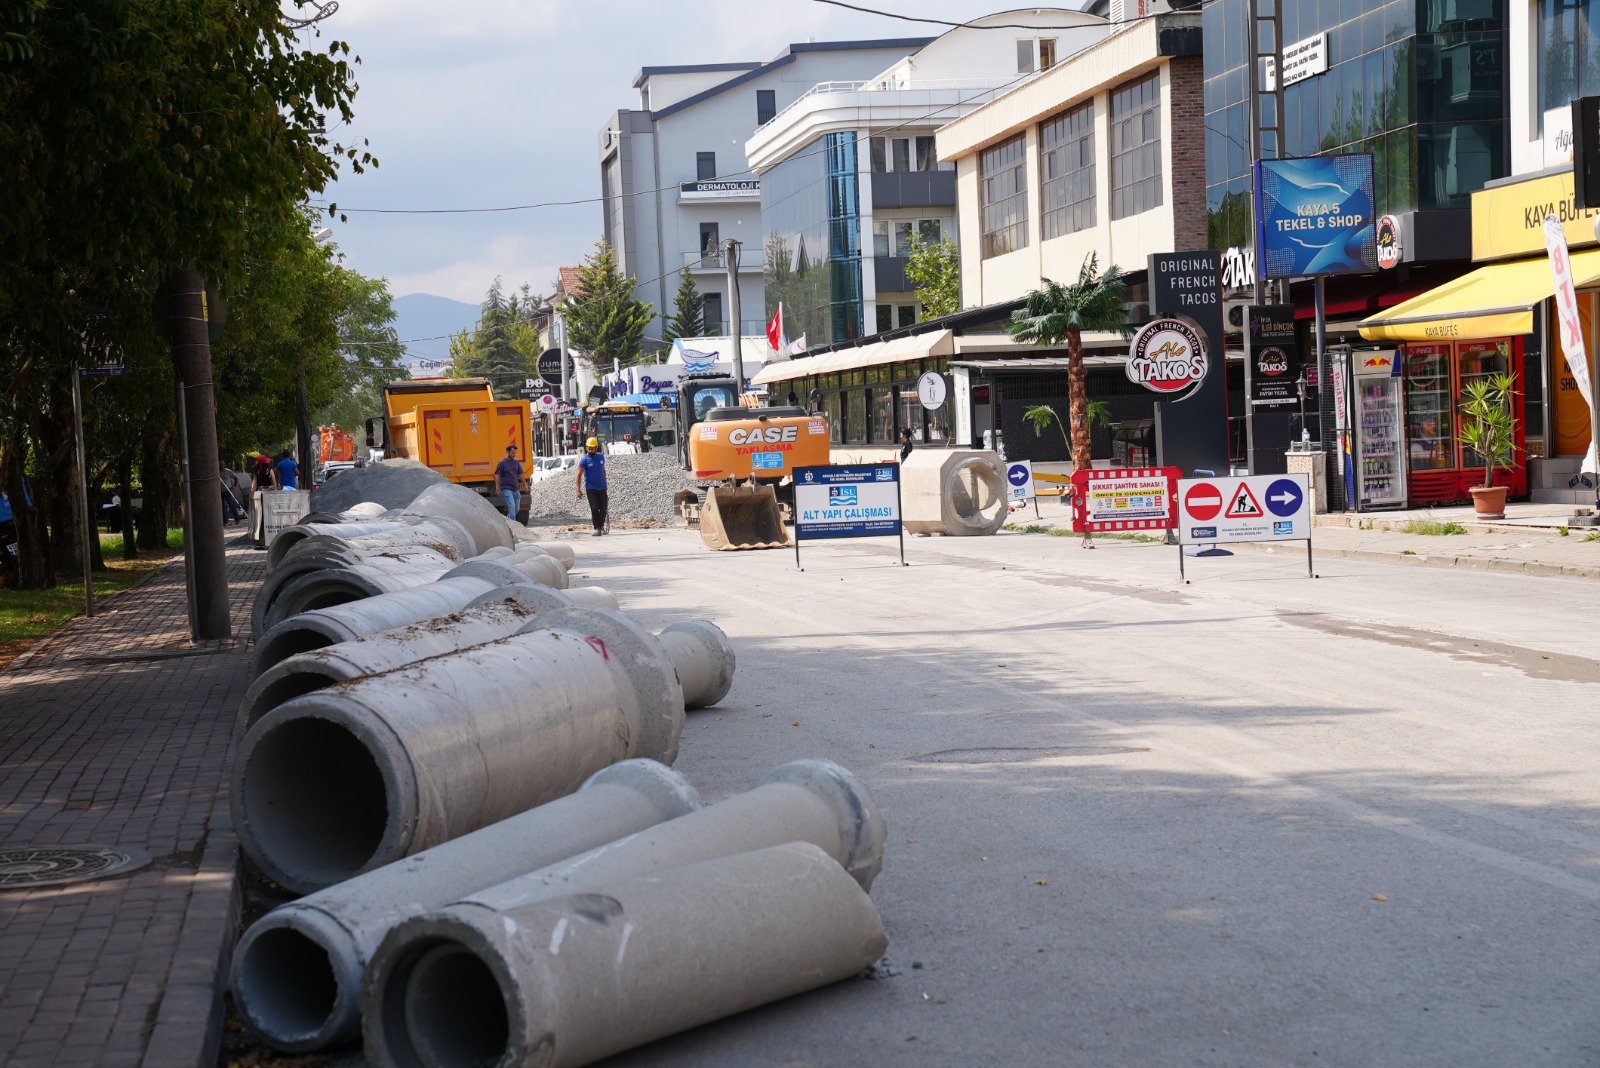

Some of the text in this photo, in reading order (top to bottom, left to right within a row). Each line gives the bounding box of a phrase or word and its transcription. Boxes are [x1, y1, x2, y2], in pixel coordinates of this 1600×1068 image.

[1297, 203, 1340, 216] KAYA 5
[1276, 215, 1362, 231] TEKEL & SHOP
[1171, 276, 1216, 288] FRENCH
[1180, 292, 1216, 305] TACOS
[1138, 322, 1199, 352] ORIGINAL FRENCH TACOS
[1130, 356, 1205, 381] TAKOS
[1257, 361, 1287, 372] TAKOS
[641, 376, 673, 393] Beyaz
[728, 426, 798, 445] CASE
[1114, 482, 1138, 490] ŞANTİYE
[803, 507, 892, 520] ALT YAPI ÇALIŞMASI
